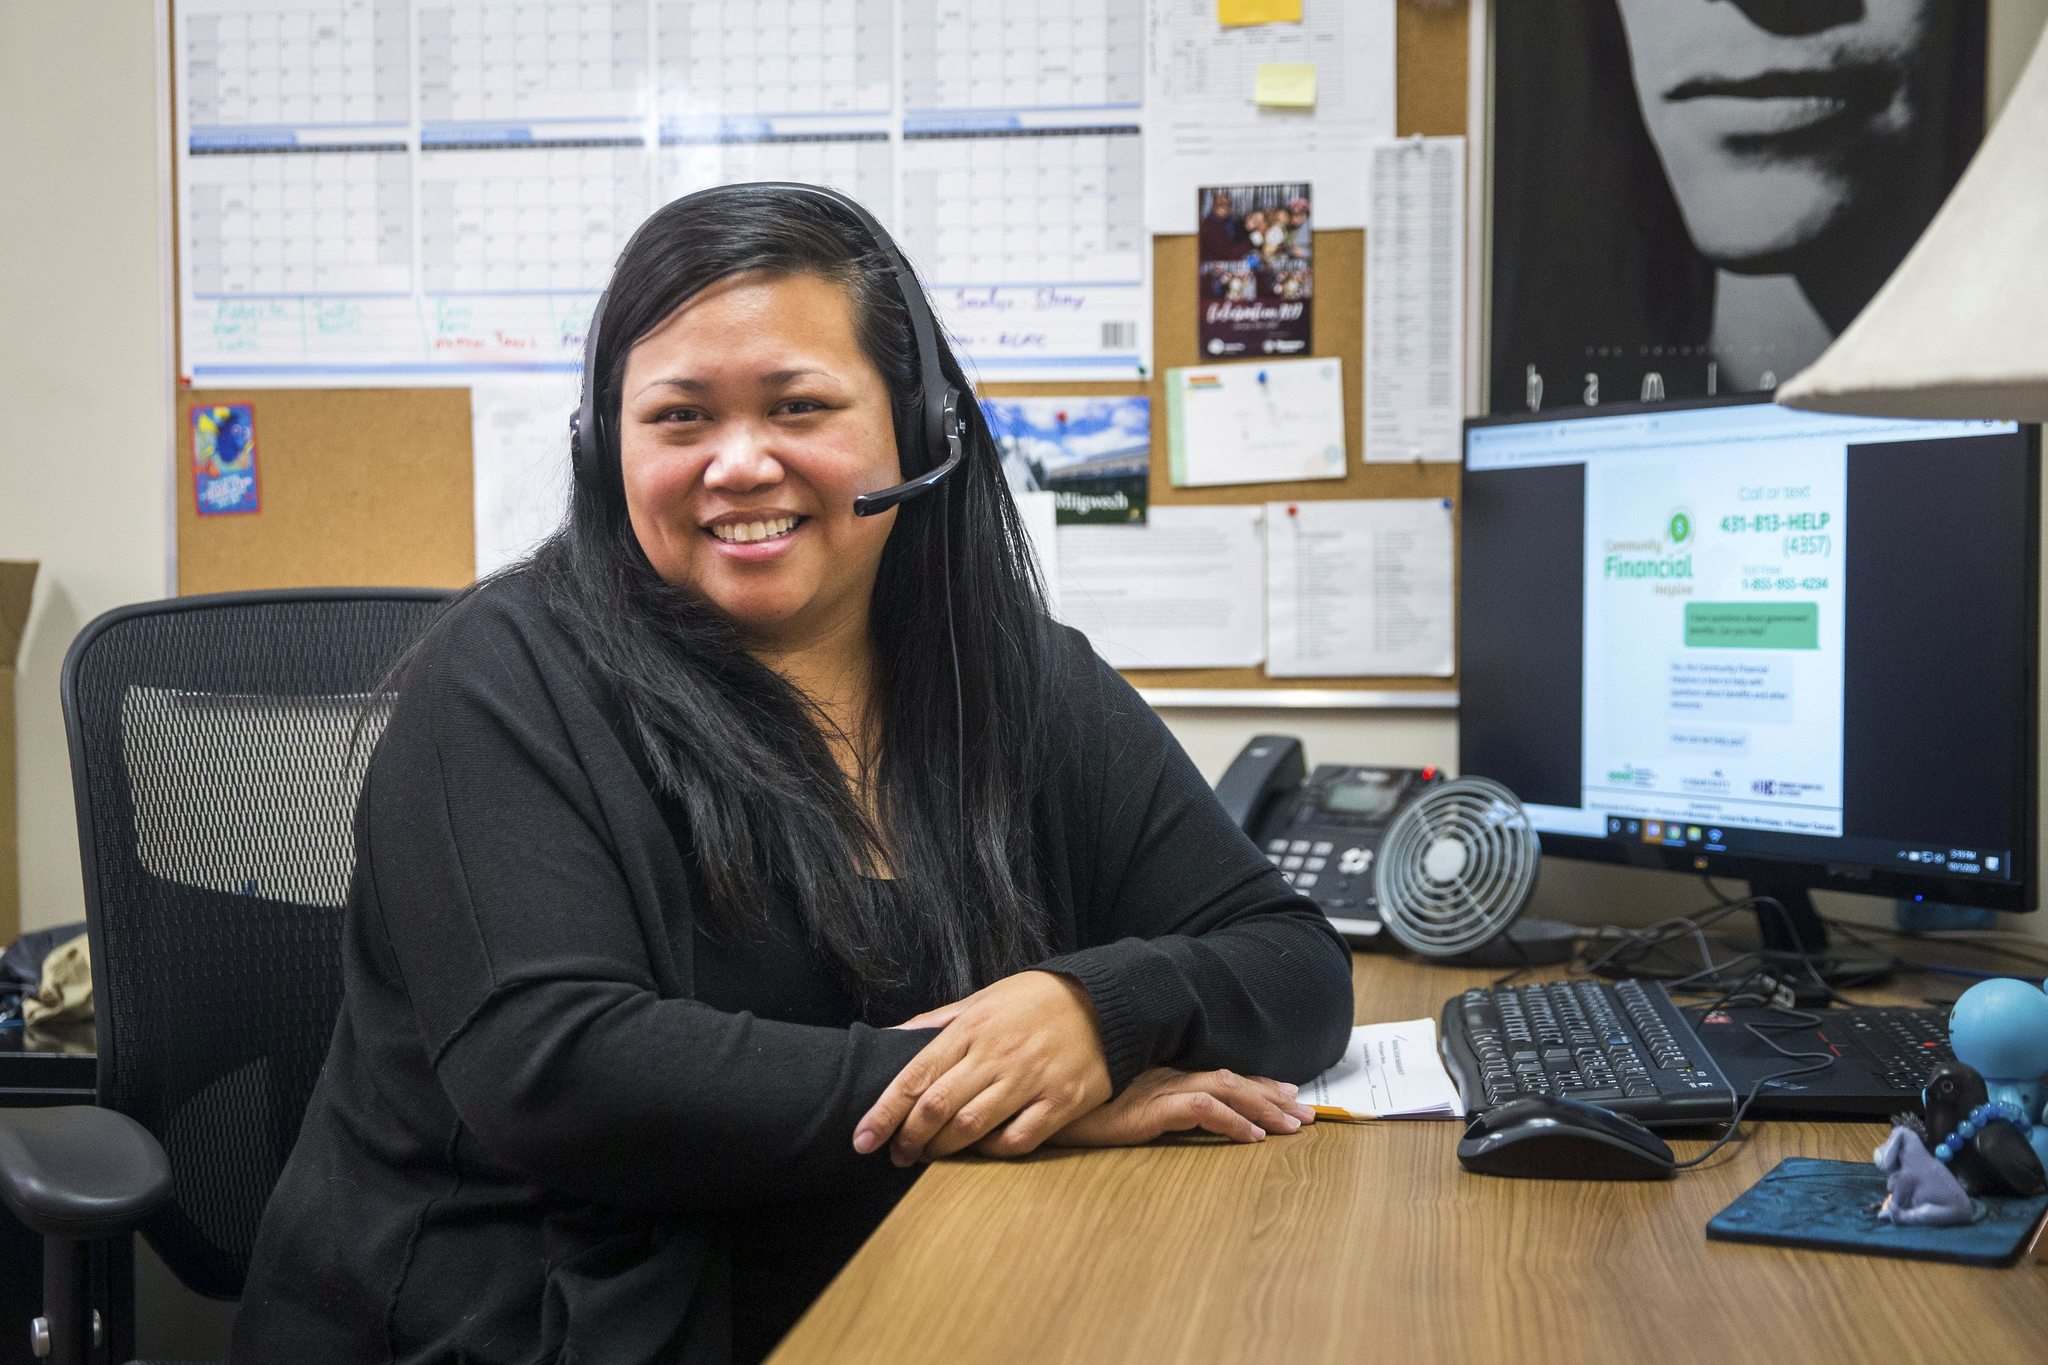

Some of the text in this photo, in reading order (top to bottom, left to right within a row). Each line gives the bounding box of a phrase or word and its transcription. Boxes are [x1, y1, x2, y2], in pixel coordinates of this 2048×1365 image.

[1720, 512, 1831, 532] 431-813-HELP
[1782, 536, 1832, 557] (4357)
[1604, 554, 1693, 578] Financial
